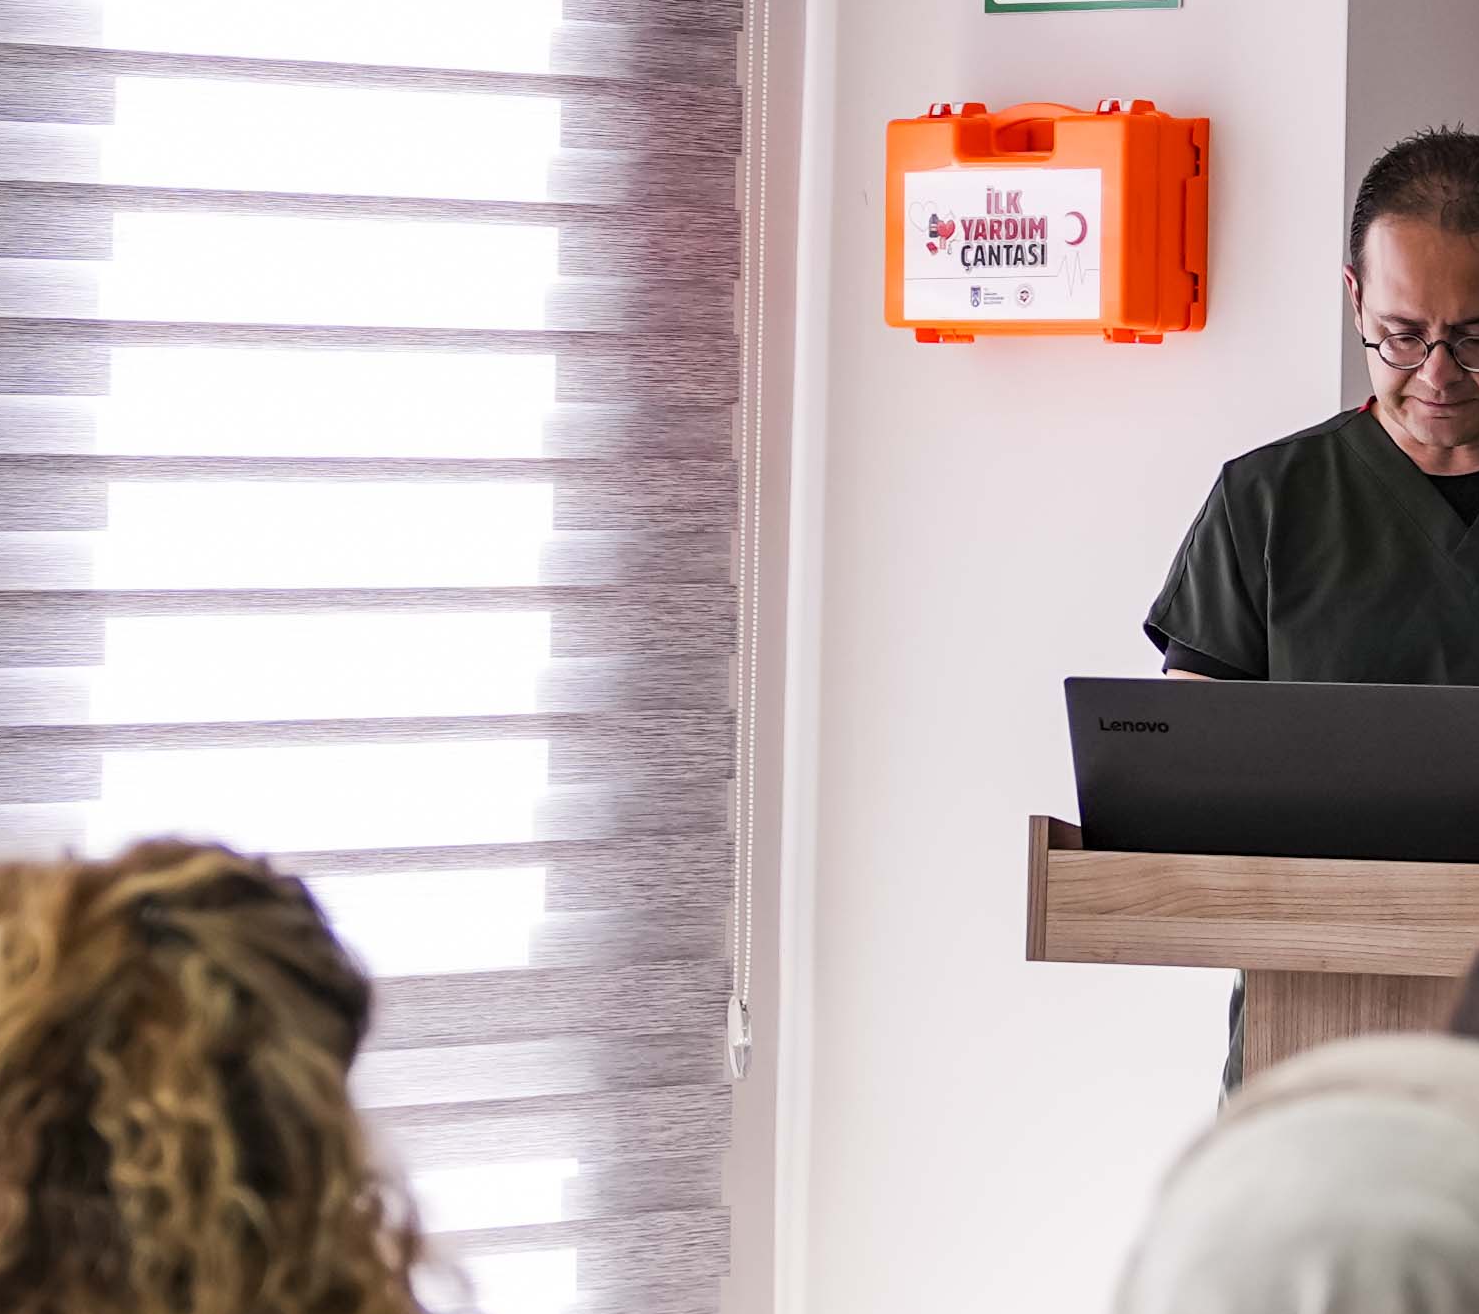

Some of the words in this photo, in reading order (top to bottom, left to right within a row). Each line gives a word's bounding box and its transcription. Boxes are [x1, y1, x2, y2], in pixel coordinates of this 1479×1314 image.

[986, 186, 1022, 215] İLK
[960, 216, 1047, 242] YARDIM
[960, 243, 1047, 271] ÇANTASI
[1098, 717, 1170, 734] Lenovo
